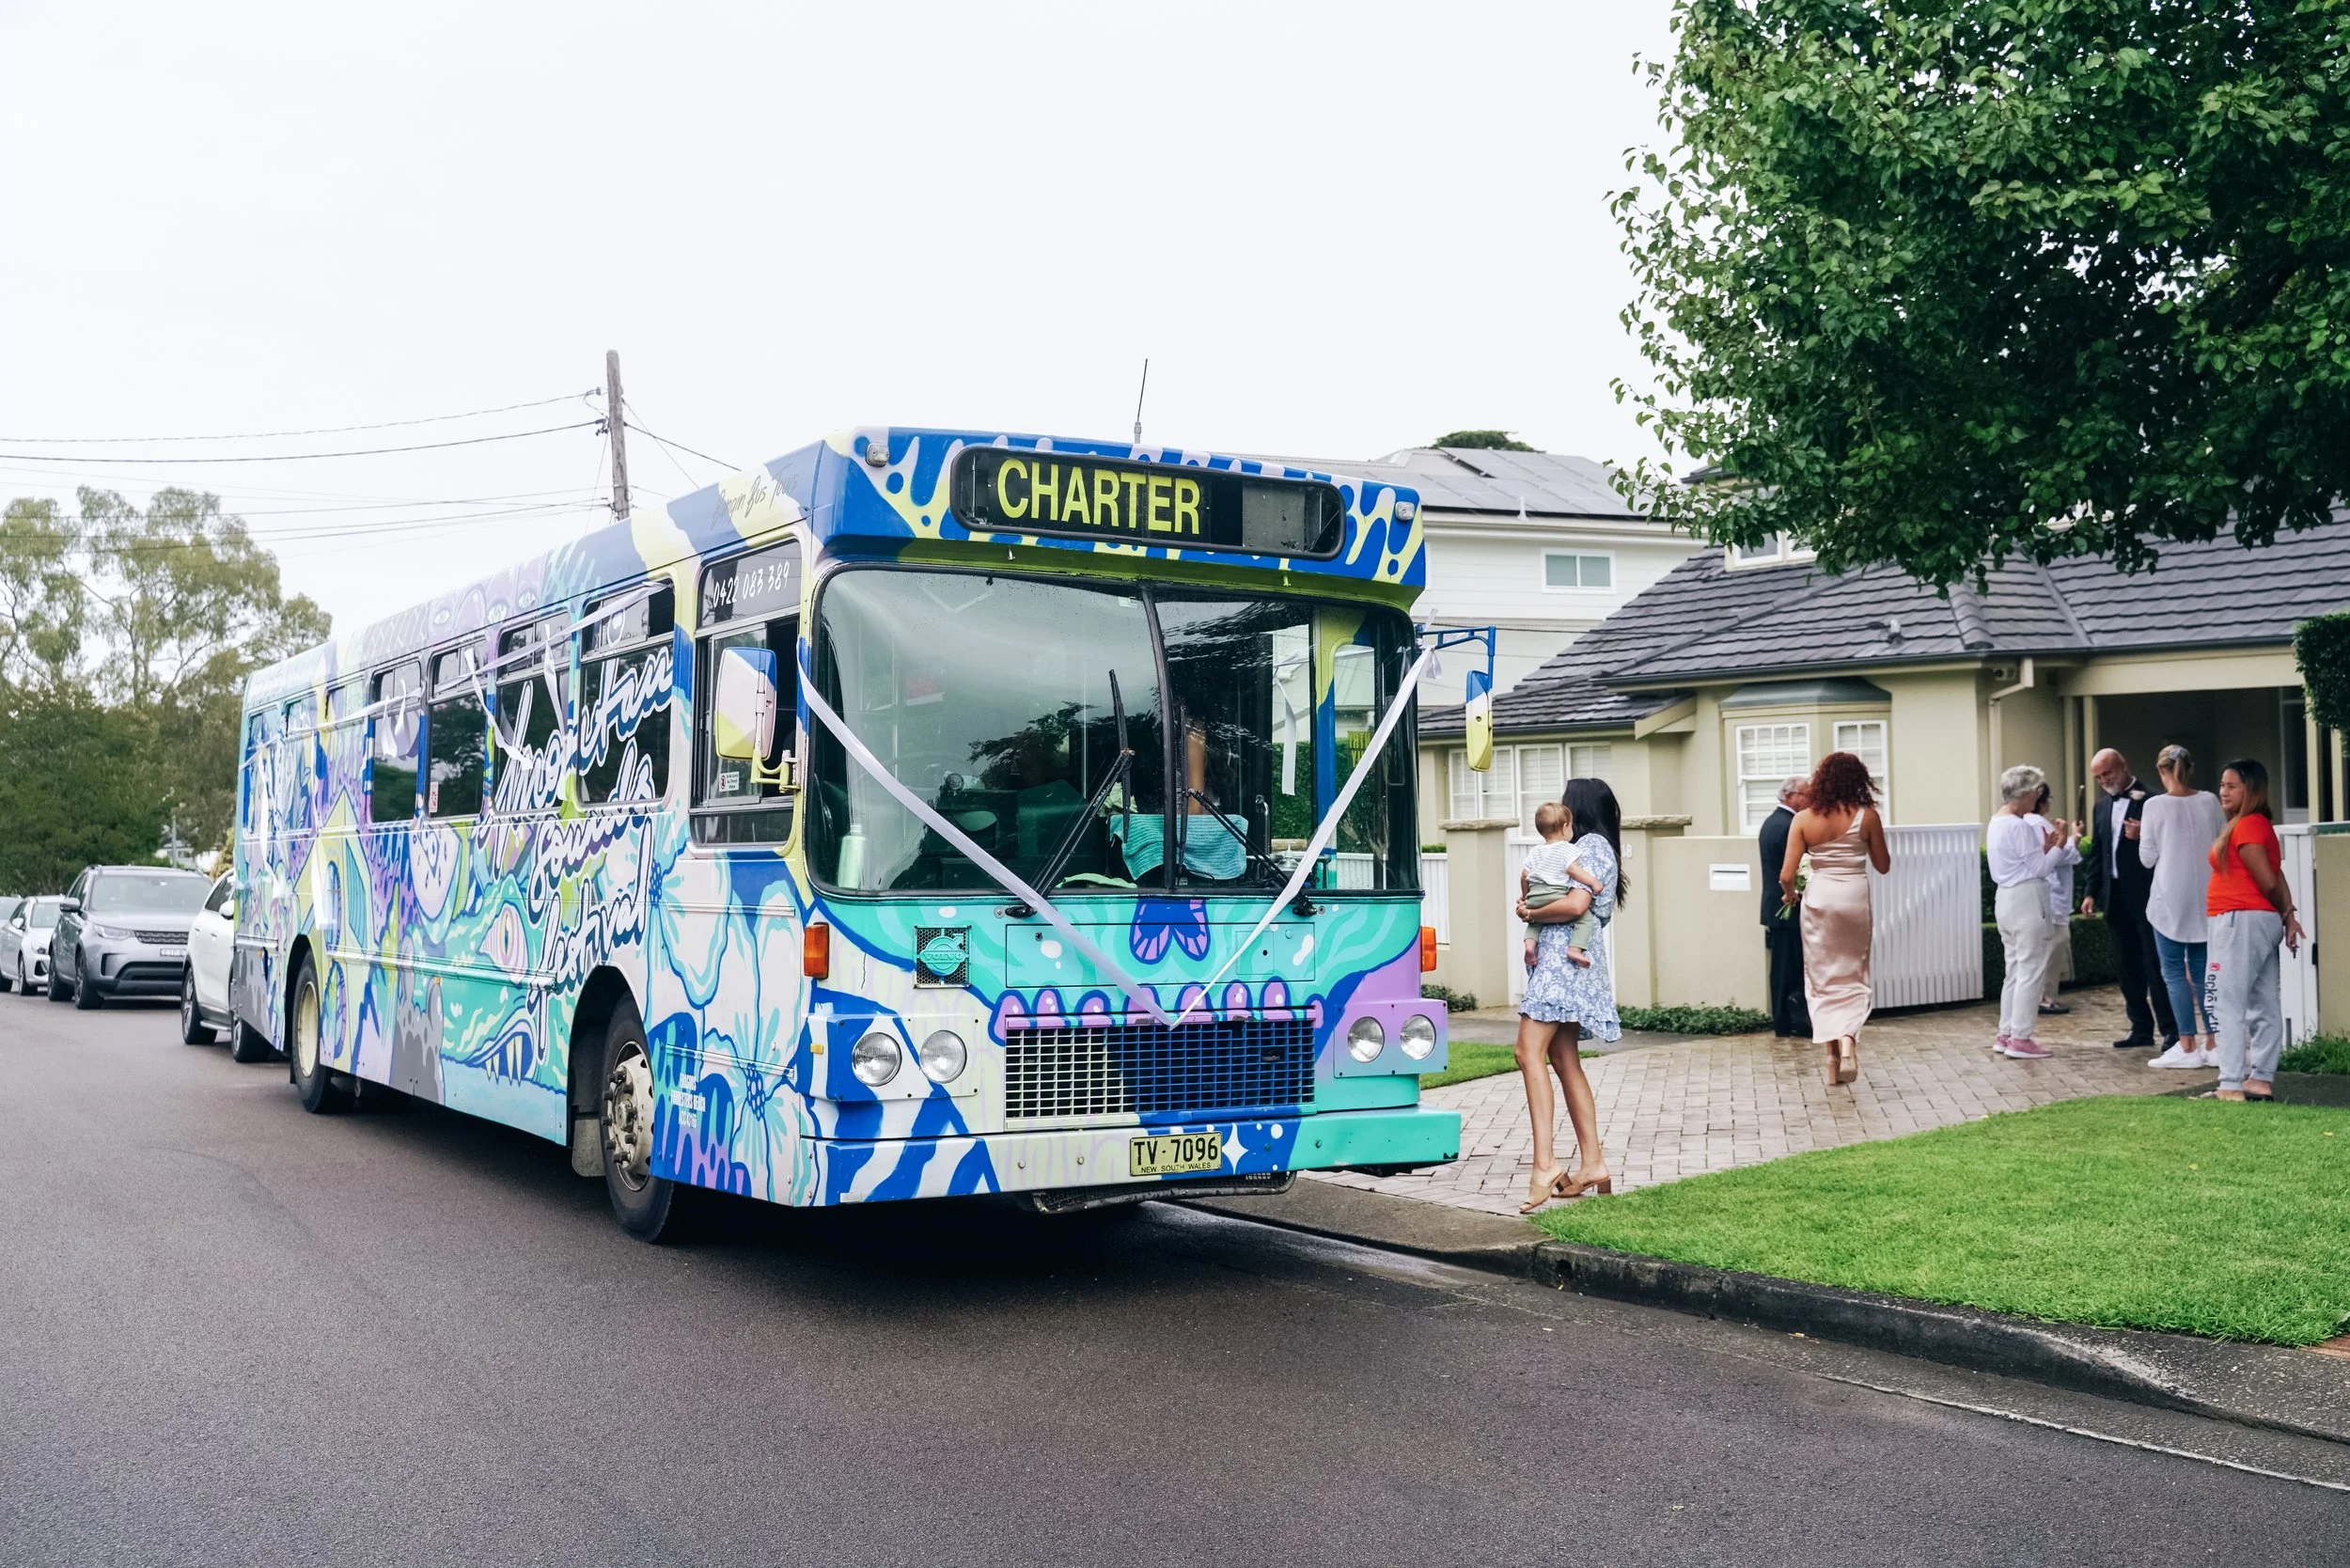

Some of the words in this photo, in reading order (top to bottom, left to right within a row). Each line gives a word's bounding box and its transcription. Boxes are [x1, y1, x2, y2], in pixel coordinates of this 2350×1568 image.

[744, 475, 767, 518] Bus
[997, 458, 1201, 535] CHARTER
[713, 575, 740, 608] 0422
[742, 568, 764, 600] 083
[767, 560, 790, 593] 389
[922, 952, 964, 961] VOLVO
